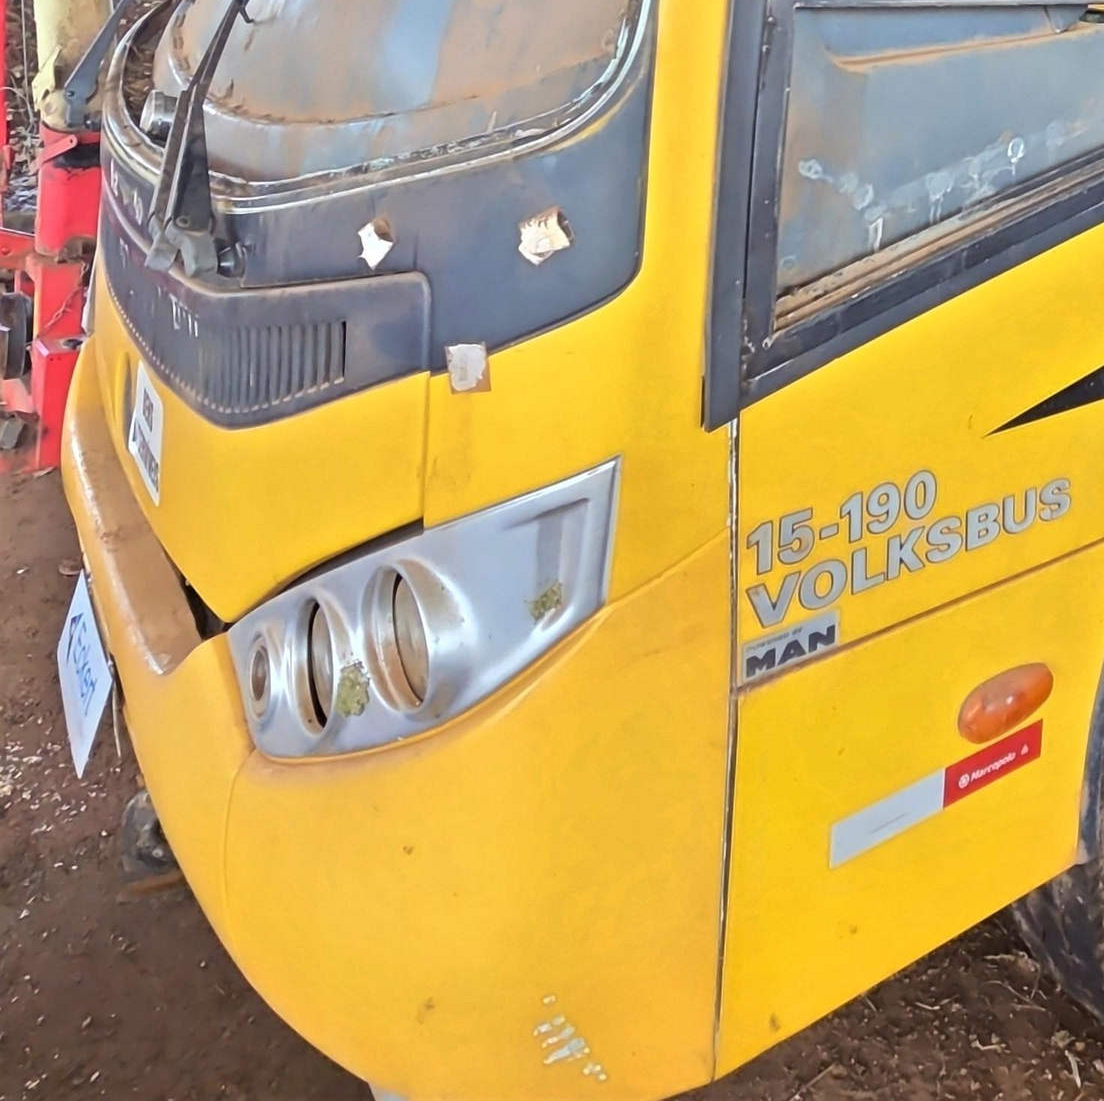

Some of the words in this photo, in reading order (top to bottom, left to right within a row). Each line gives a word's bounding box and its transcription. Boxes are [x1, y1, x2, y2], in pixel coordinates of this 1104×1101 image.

[745, 477, 1072, 629] VOLKSBUS
[746, 469, 938, 576] 15-190
[745, 623, 836, 678] MAN
[970, 752, 1016, 782] Marcopolo
